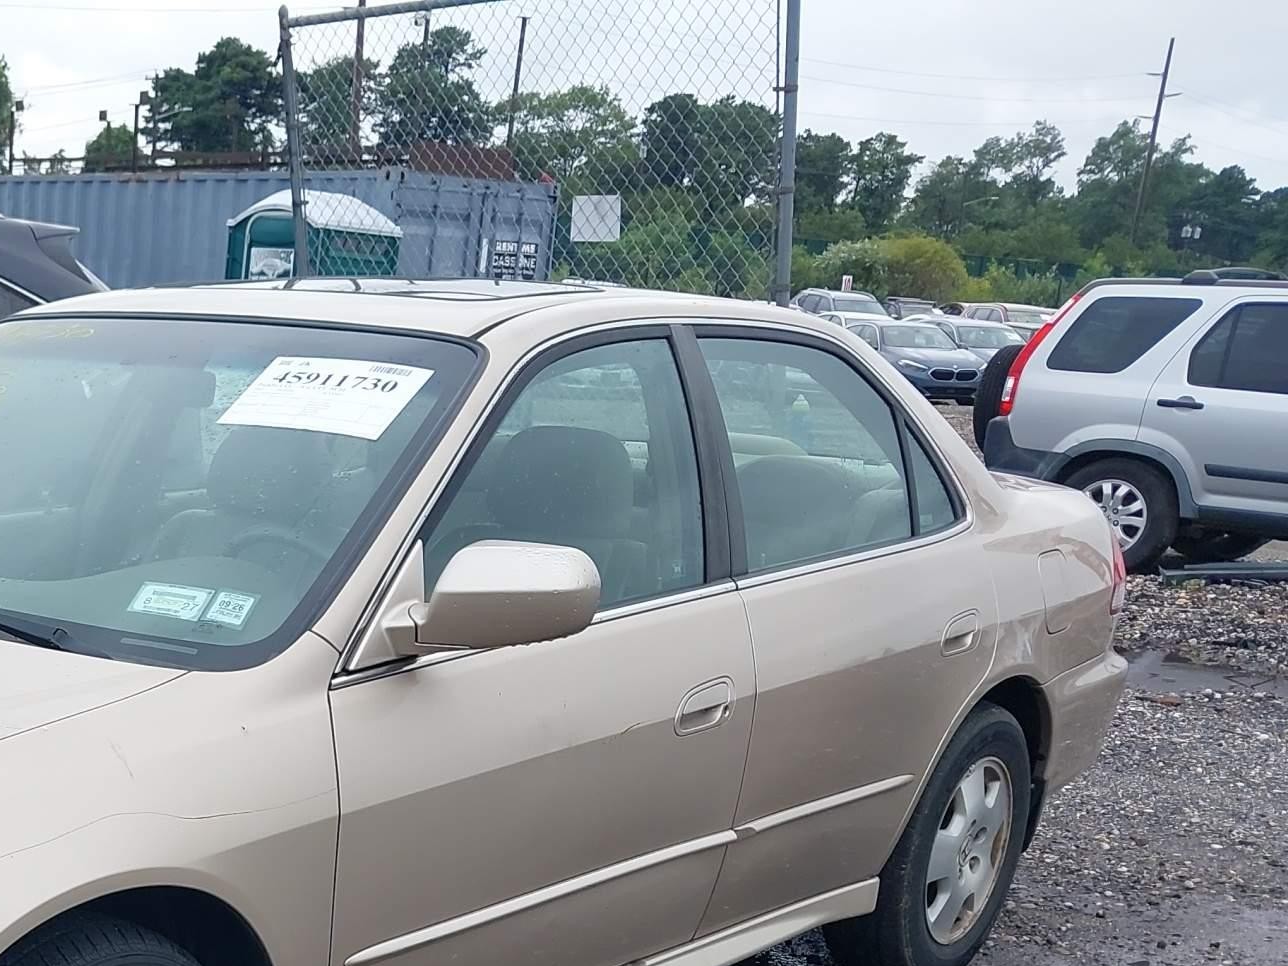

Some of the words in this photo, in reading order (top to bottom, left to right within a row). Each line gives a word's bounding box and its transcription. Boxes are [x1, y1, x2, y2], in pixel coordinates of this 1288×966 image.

[496, 241, 518, 253] RENT
[521, 243, 536, 254] ME
[273, 370, 399, 393] 45911730
[181, 602, 201, 611] 27
